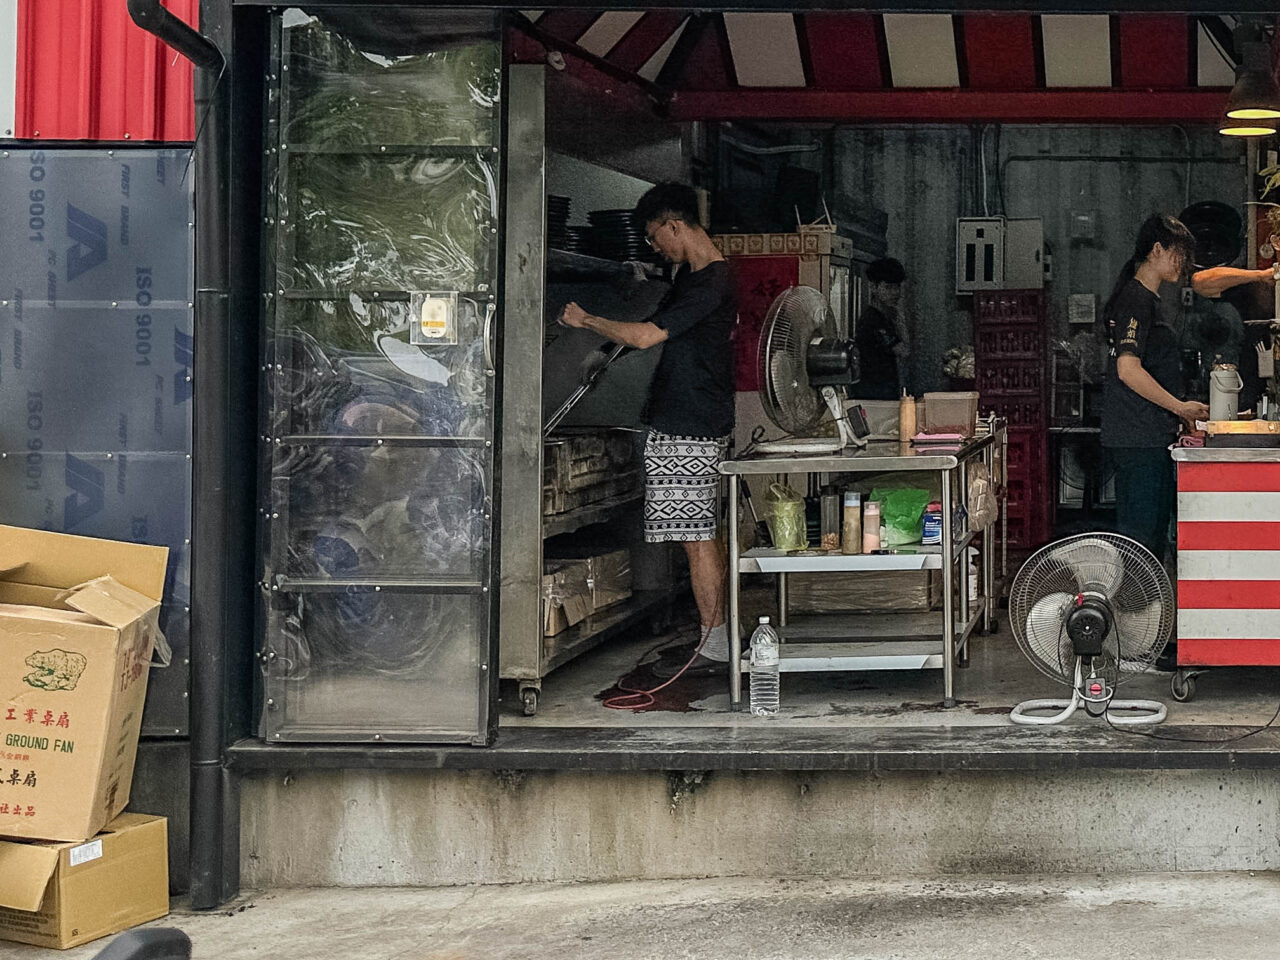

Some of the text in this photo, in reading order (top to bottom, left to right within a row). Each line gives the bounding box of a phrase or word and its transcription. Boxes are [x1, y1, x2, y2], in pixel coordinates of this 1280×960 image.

[136, 267, 152, 367] ISO 9001
[5, 733, 75, 753] GROUND FAN
